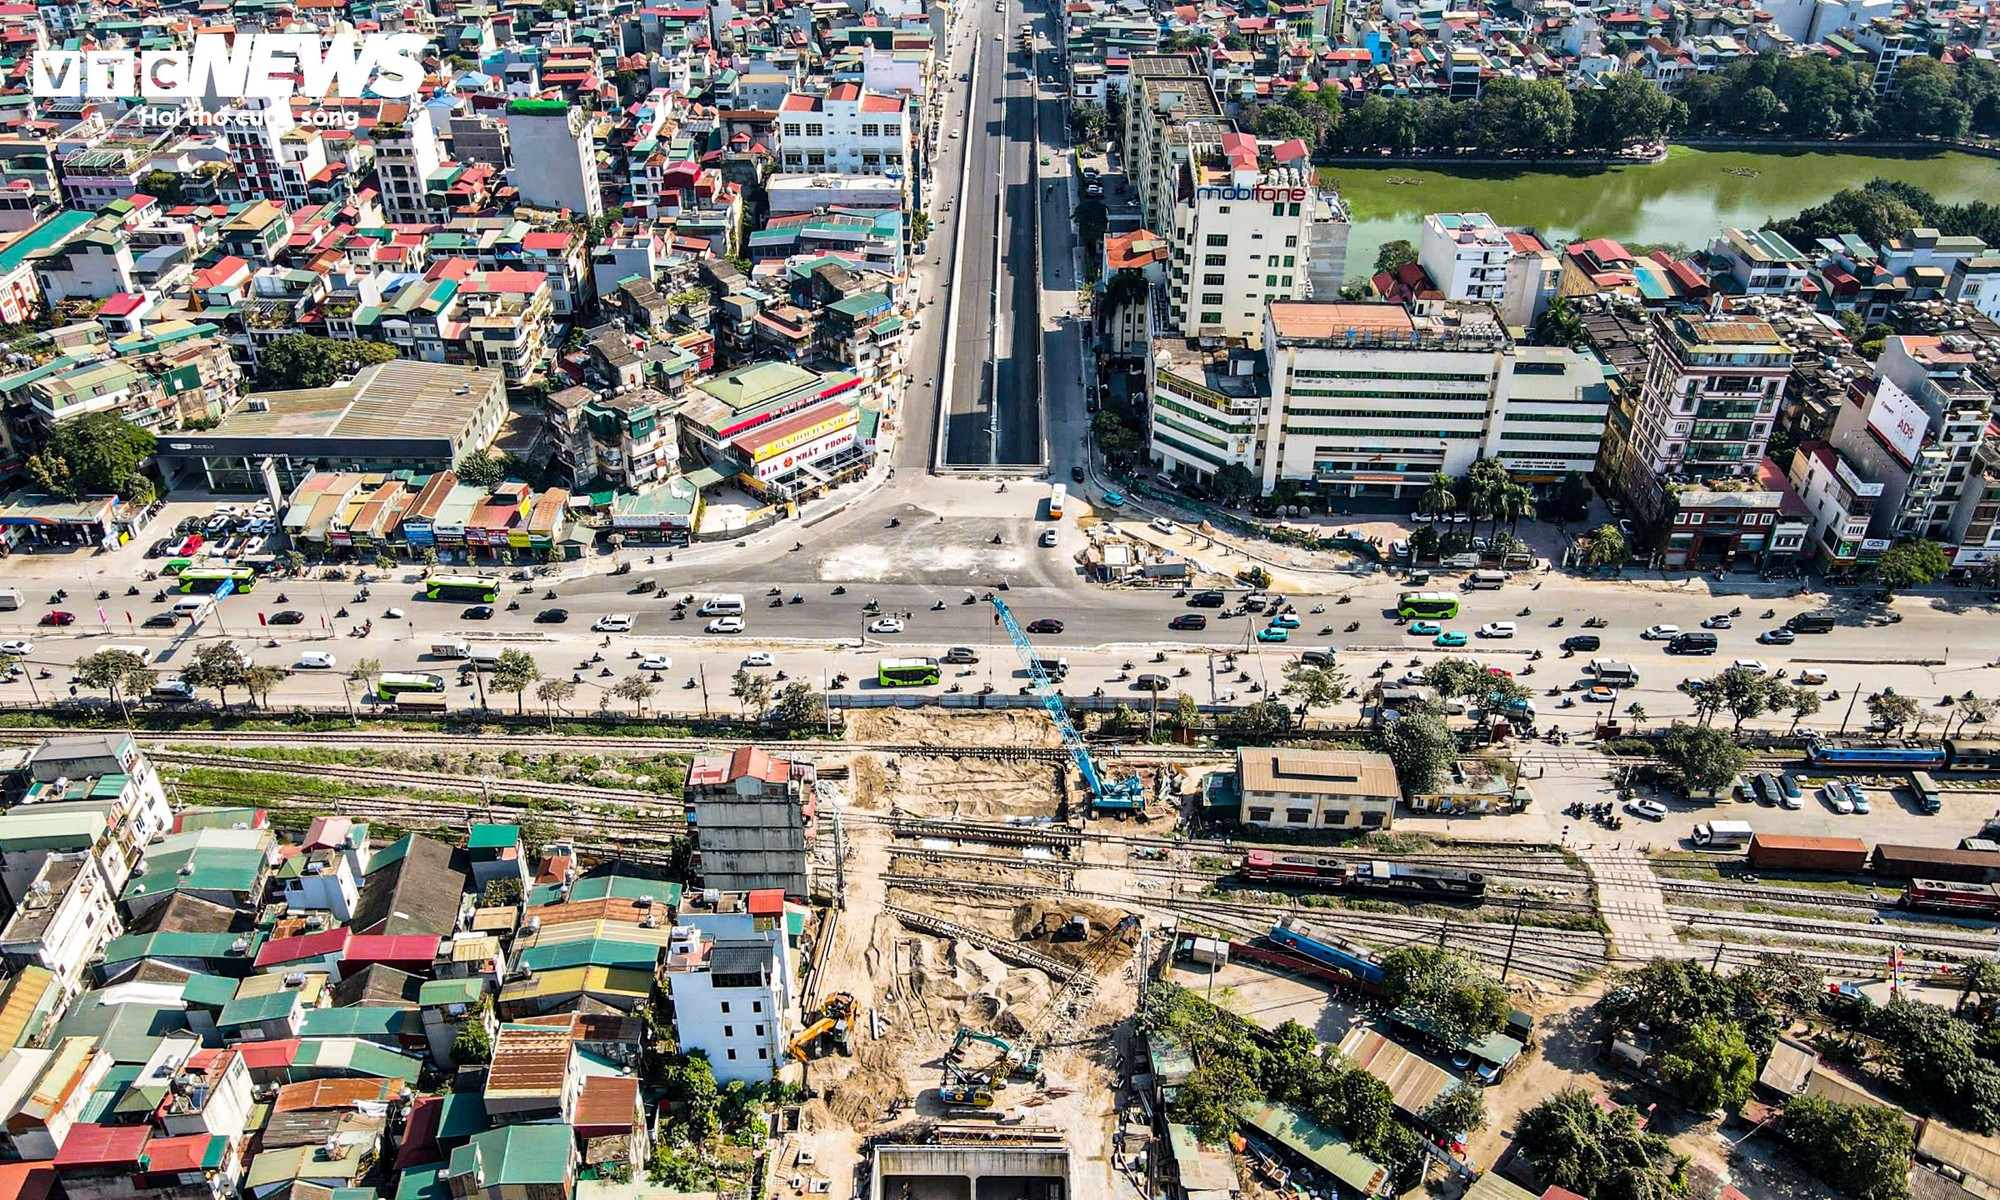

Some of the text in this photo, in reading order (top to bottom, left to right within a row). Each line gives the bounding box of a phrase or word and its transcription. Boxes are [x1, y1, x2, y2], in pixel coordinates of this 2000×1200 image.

[1196, 183, 1306, 202] mobifone
[1897, 419, 1915, 440] ADS
[760, 464, 778, 476] BIA
[825, 432, 853, 450] PHONG
